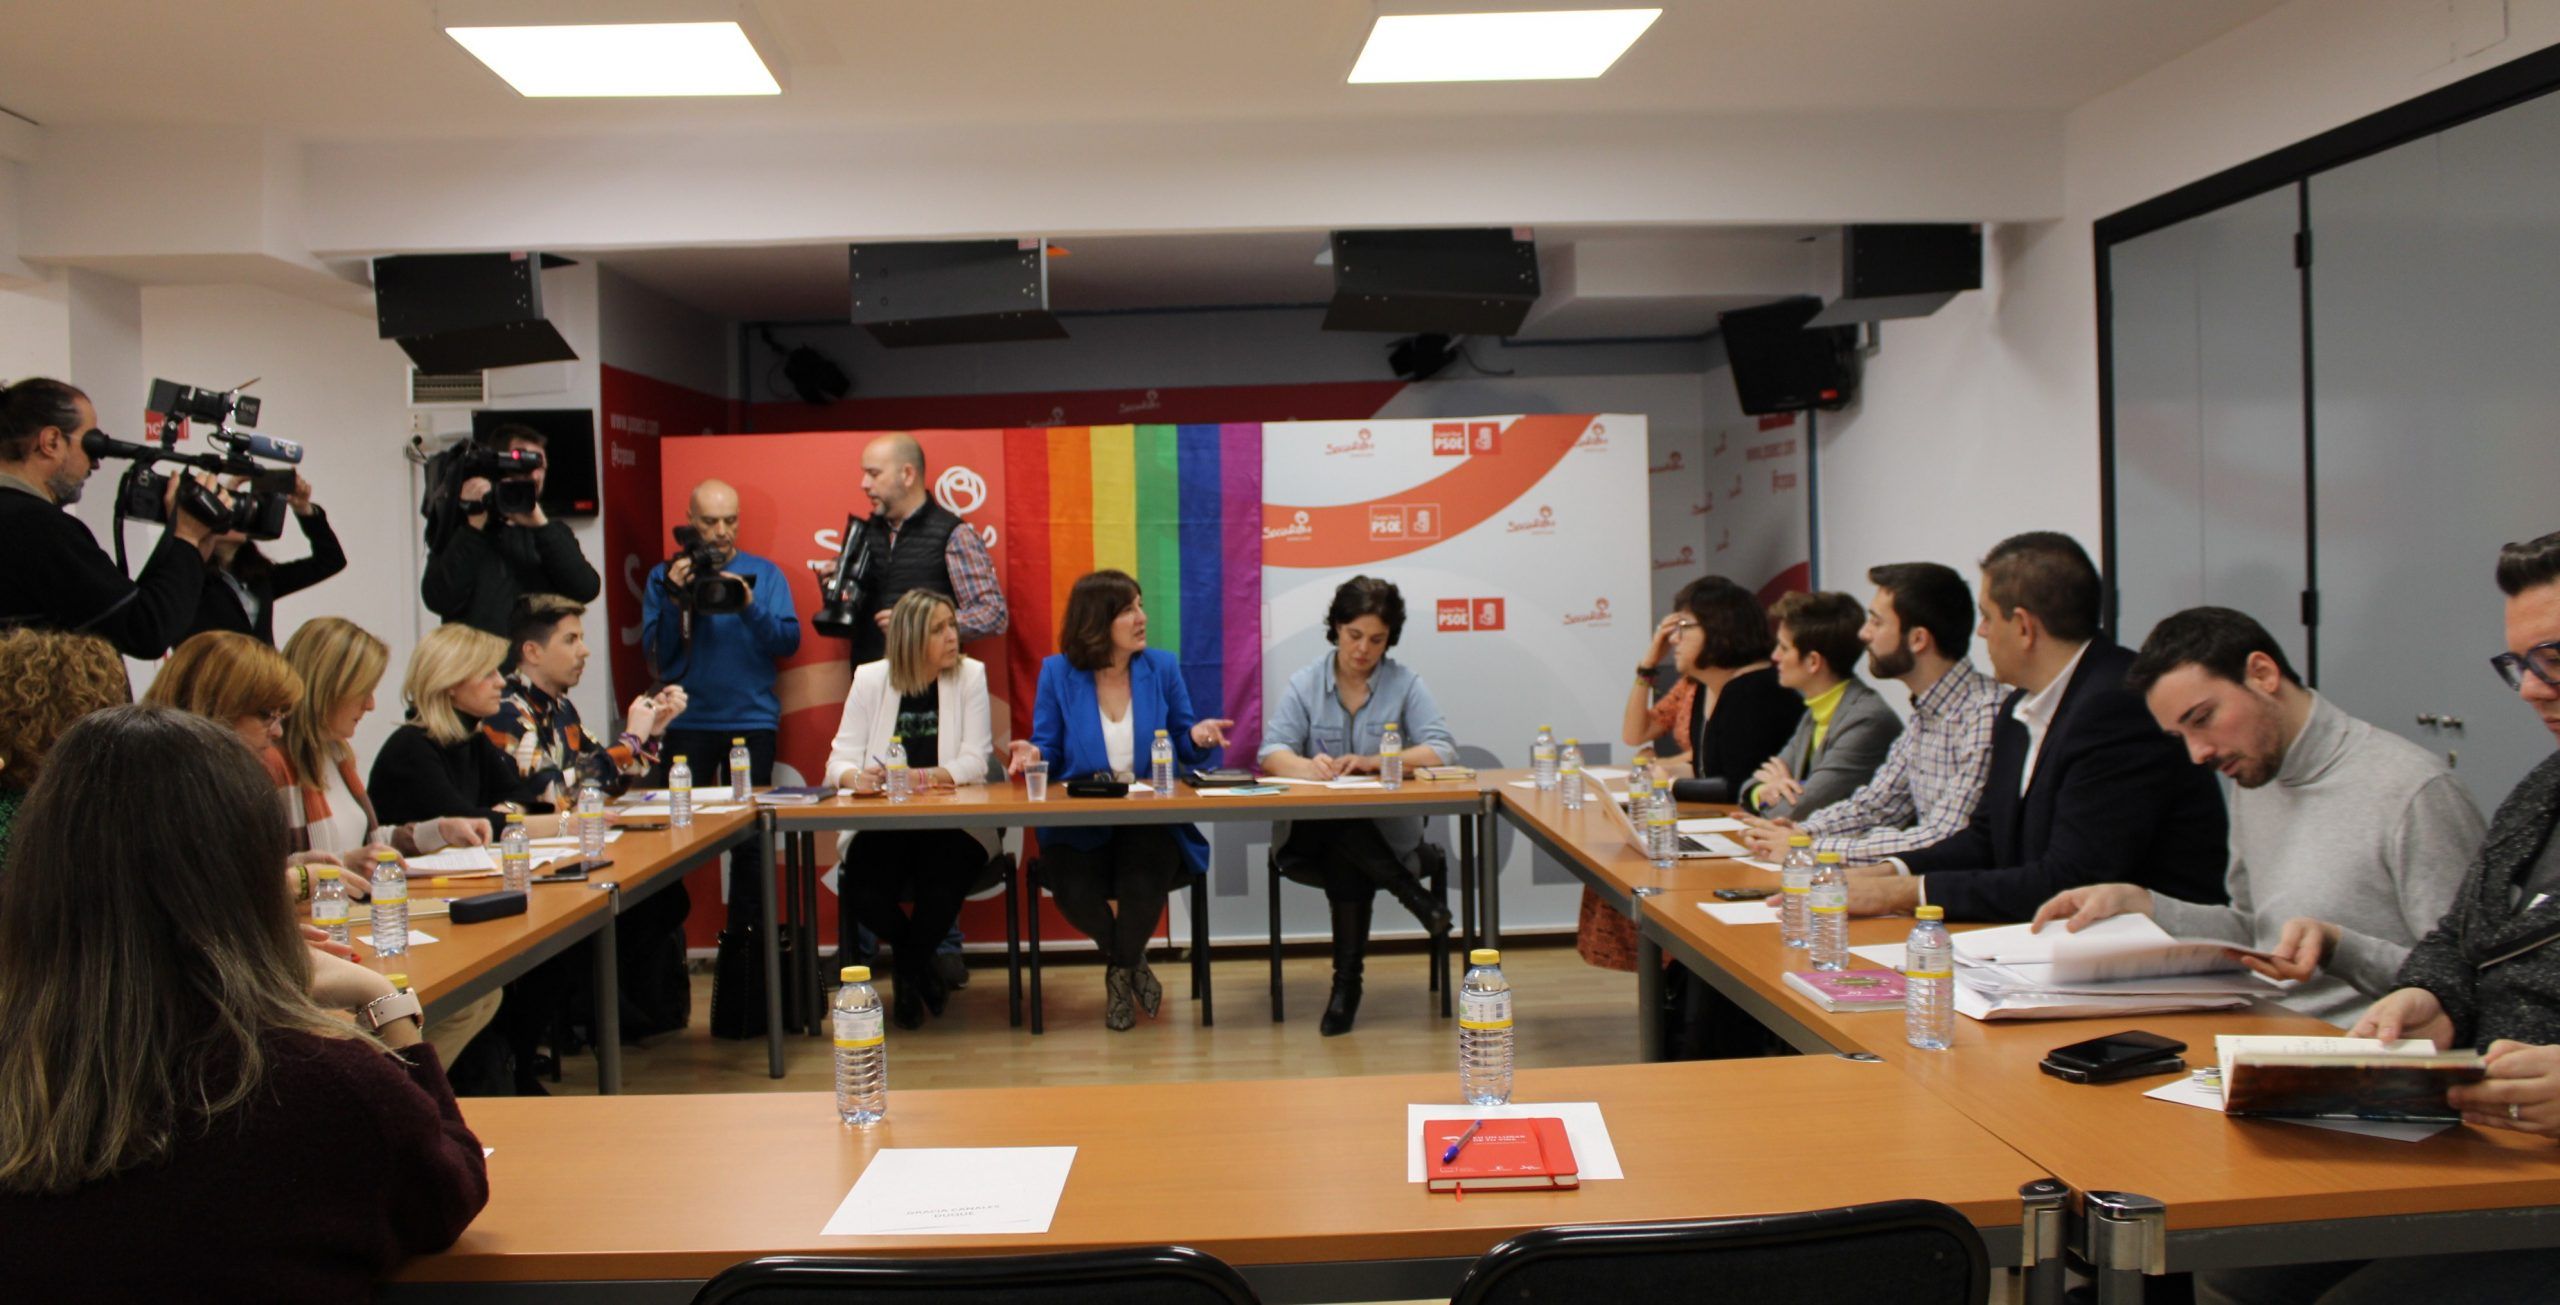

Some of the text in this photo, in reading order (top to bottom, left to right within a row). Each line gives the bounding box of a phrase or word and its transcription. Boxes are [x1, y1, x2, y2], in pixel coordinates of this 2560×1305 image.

[1434, 437, 1464, 450] PSOE
[1371, 520, 1402, 534] PSOE
[1439, 613, 1468, 626] PSOE
